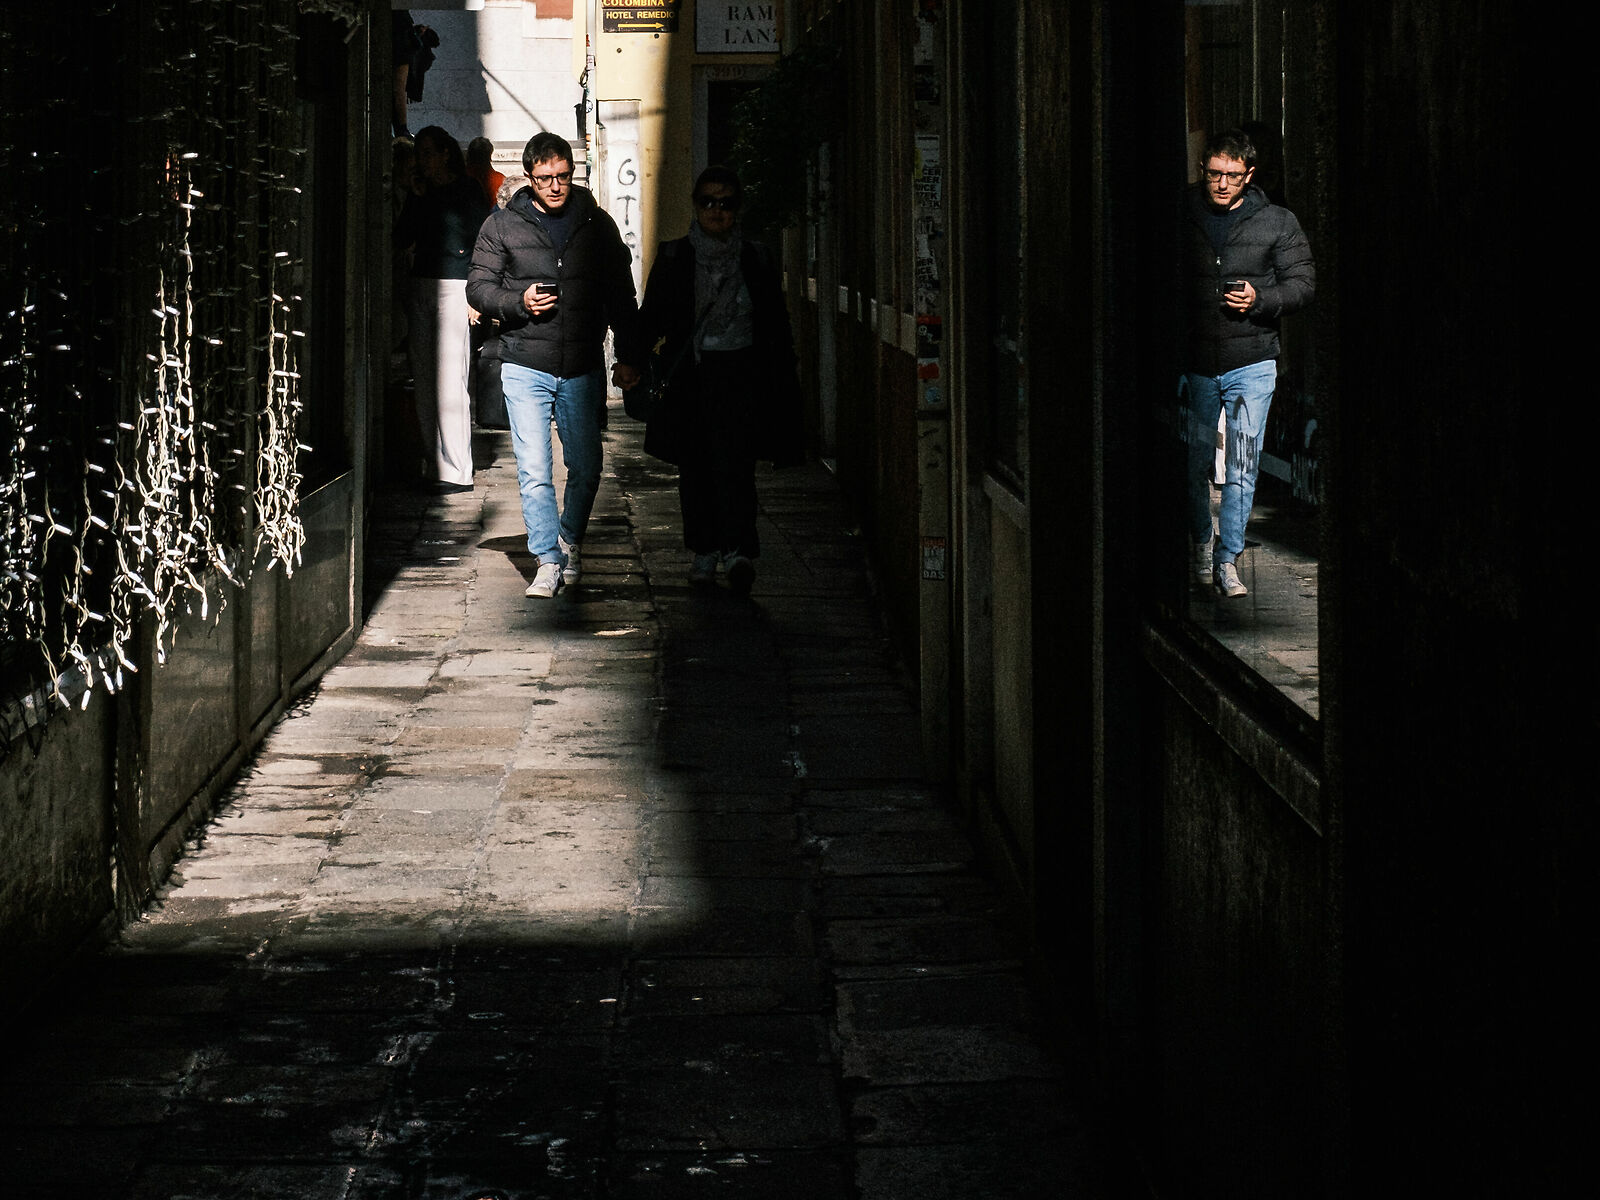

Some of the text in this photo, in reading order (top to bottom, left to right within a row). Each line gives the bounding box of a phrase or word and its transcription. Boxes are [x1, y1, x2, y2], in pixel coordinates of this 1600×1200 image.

[606, 10, 675, 19] HOTEL REMEDIO
[728, 5, 776, 21] RAM
